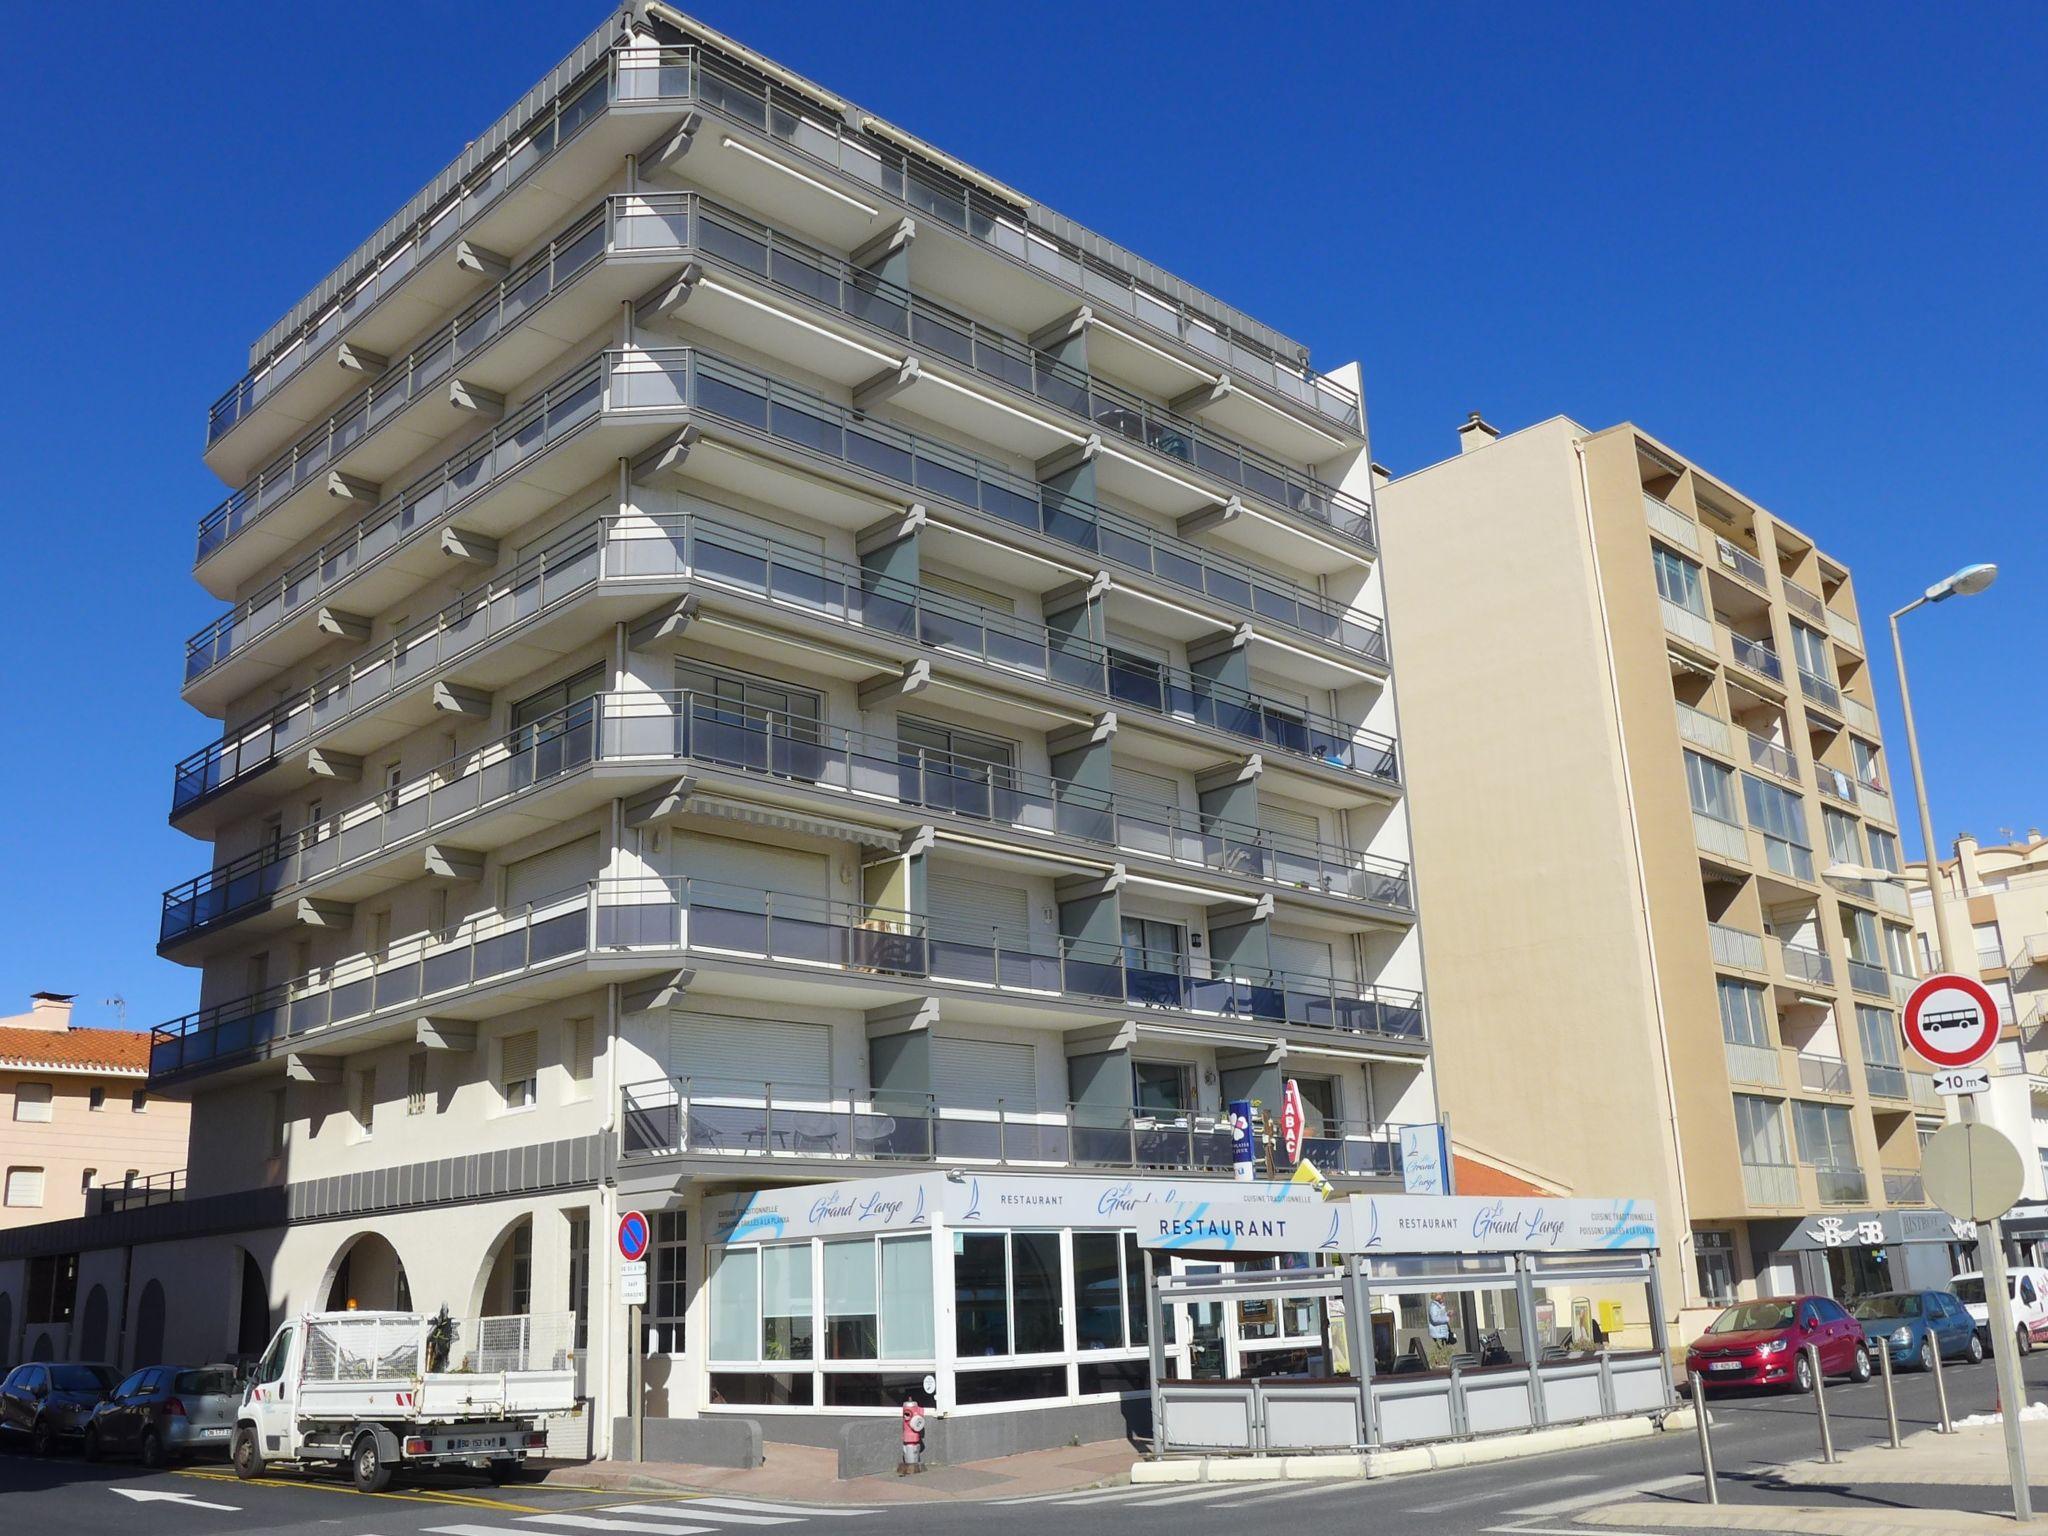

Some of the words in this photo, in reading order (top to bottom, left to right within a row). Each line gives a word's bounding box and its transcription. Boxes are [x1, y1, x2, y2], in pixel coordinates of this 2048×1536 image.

[1945, 1075, 1963, 1089] 10
[1966, 1079, 1977, 1087] m
[1285, 1089, 1298, 1153] TABAC
[808, 1196, 858, 1224] Grand
[858, 1191, 904, 1223] Large
[1000, 1194, 1063, 1206] RESTAURANT
[1491, 1200, 1504, 1216] Le
[1160, 1219, 1287, 1237] RESTAURANT
[1399, 1218, 1458, 1230] RESTAURANT
[1472, 1206, 1522, 1243] Grand
[1525, 1208, 1565, 1245] Large
[1824, 1226, 1842, 1247] B
[1858, 1220, 1885, 1245] 58
